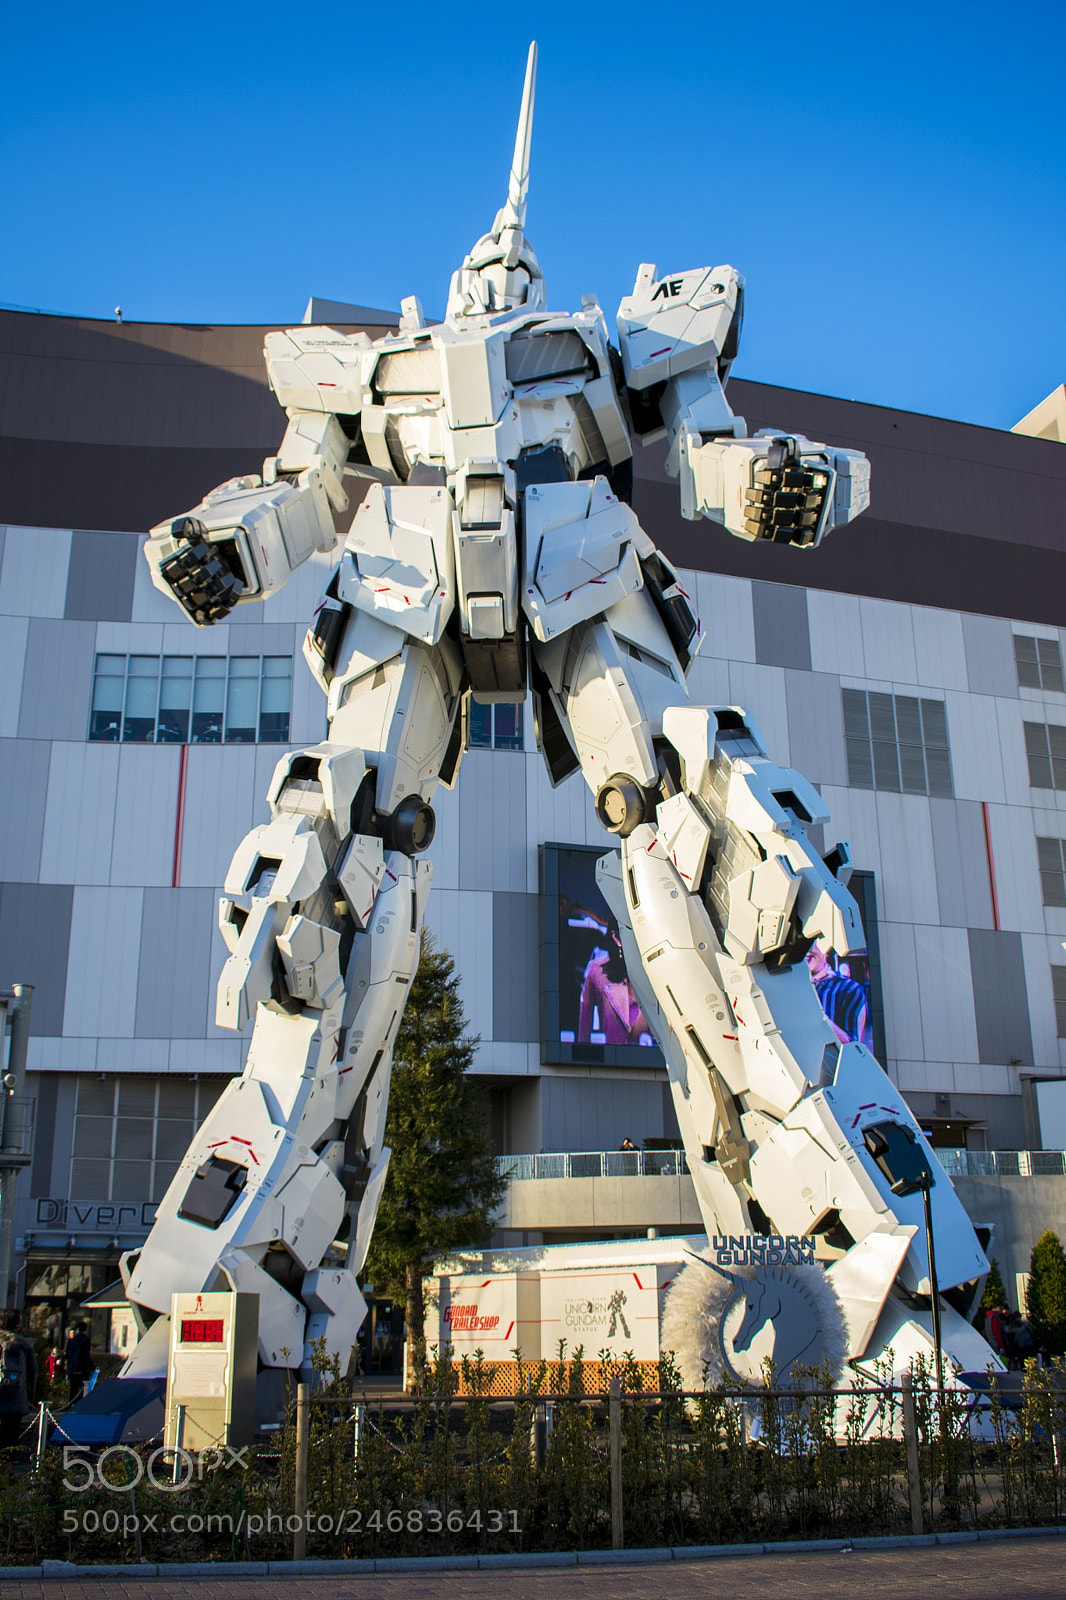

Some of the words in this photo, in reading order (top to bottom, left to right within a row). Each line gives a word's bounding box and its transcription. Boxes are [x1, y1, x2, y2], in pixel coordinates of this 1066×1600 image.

[713, 1235, 816, 1250] UNICORN
[717, 1250, 815, 1265] GUNDAM
[443, 1304, 479, 1322] GUNDAM
[565, 1314, 607, 1326] GUNDAM
